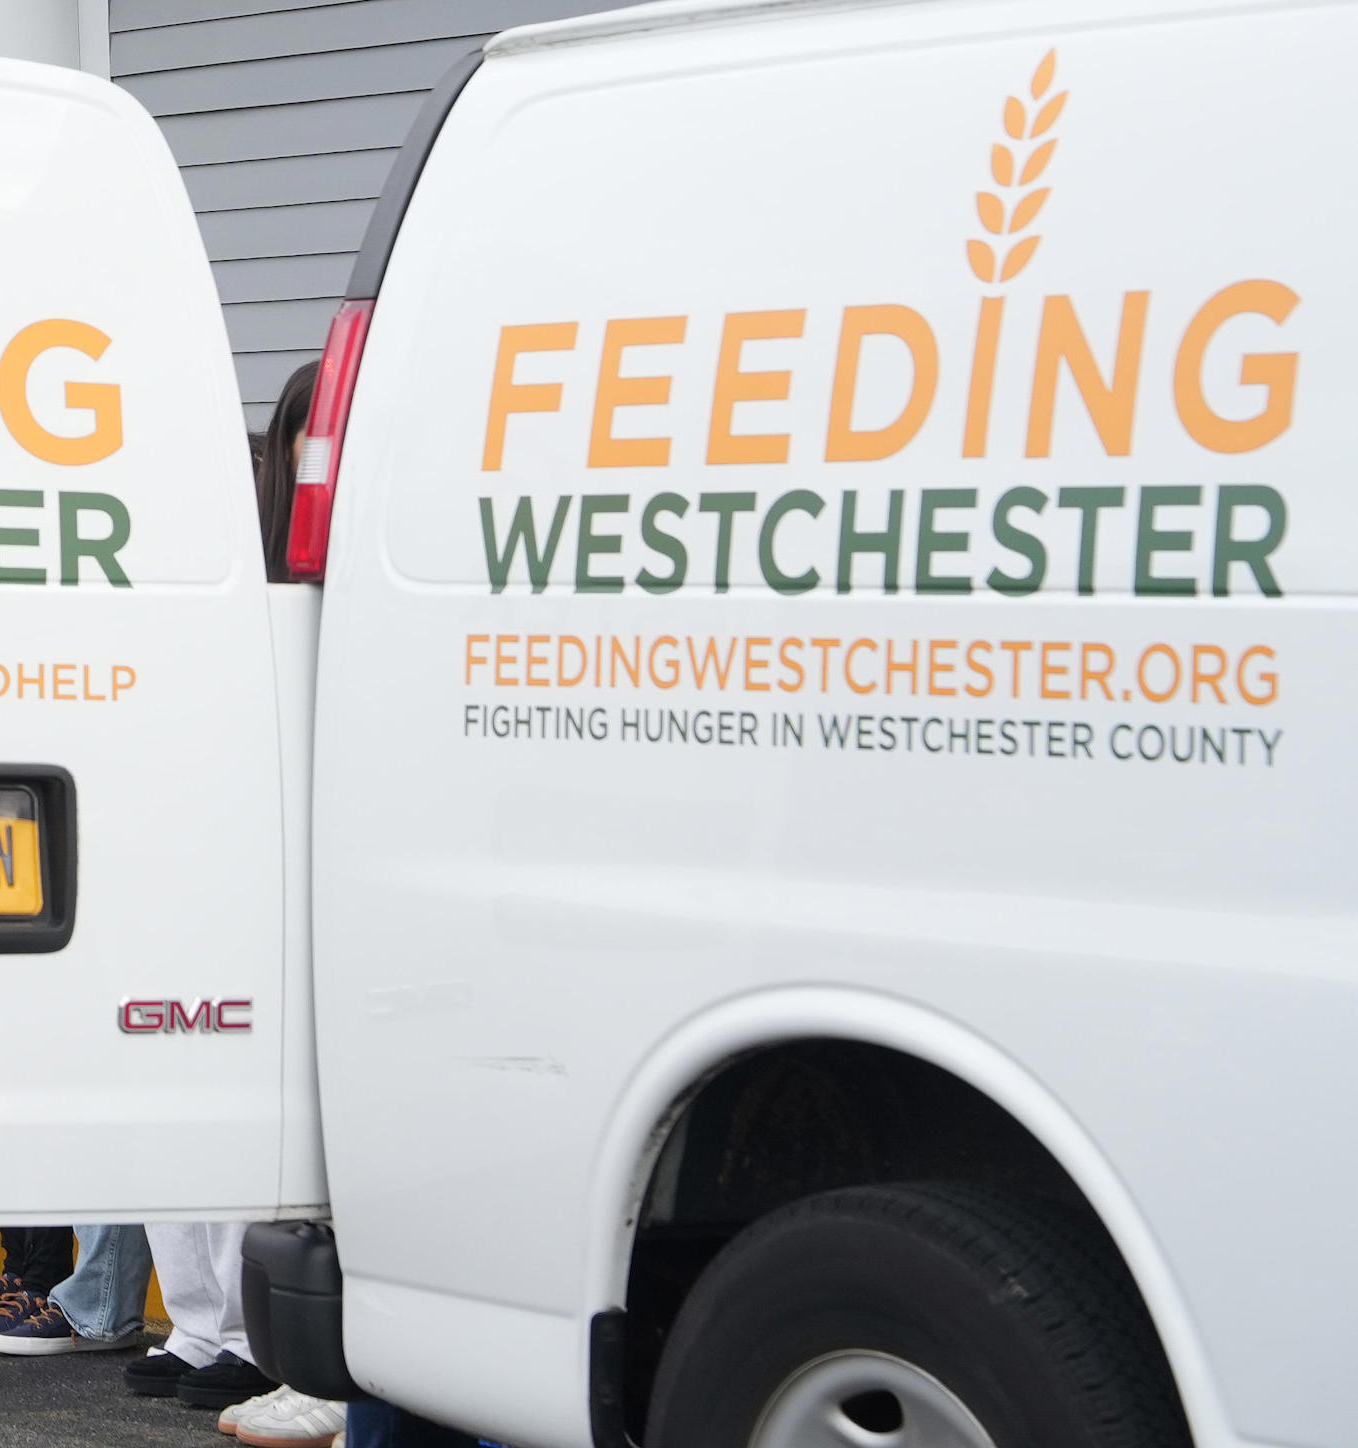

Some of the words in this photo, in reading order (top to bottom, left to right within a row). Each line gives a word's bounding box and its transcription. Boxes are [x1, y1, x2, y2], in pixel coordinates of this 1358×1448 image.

[481, 279, 1301, 471] FEEDING
[478, 484, 1288, 598] WESTCHESTER
[465, 633, 1280, 706] FEEDINGWESTCHESTER.ORG
[463, 704, 608, 741] FIGHTING
[621, 707, 759, 747] HUNGER
[771, 713, 804, 747] IN
[817, 714, 1094, 760] WESTCHESTER
[1109, 722, 1283, 768] COUNTY
[118, 996, 253, 1034] GMC
